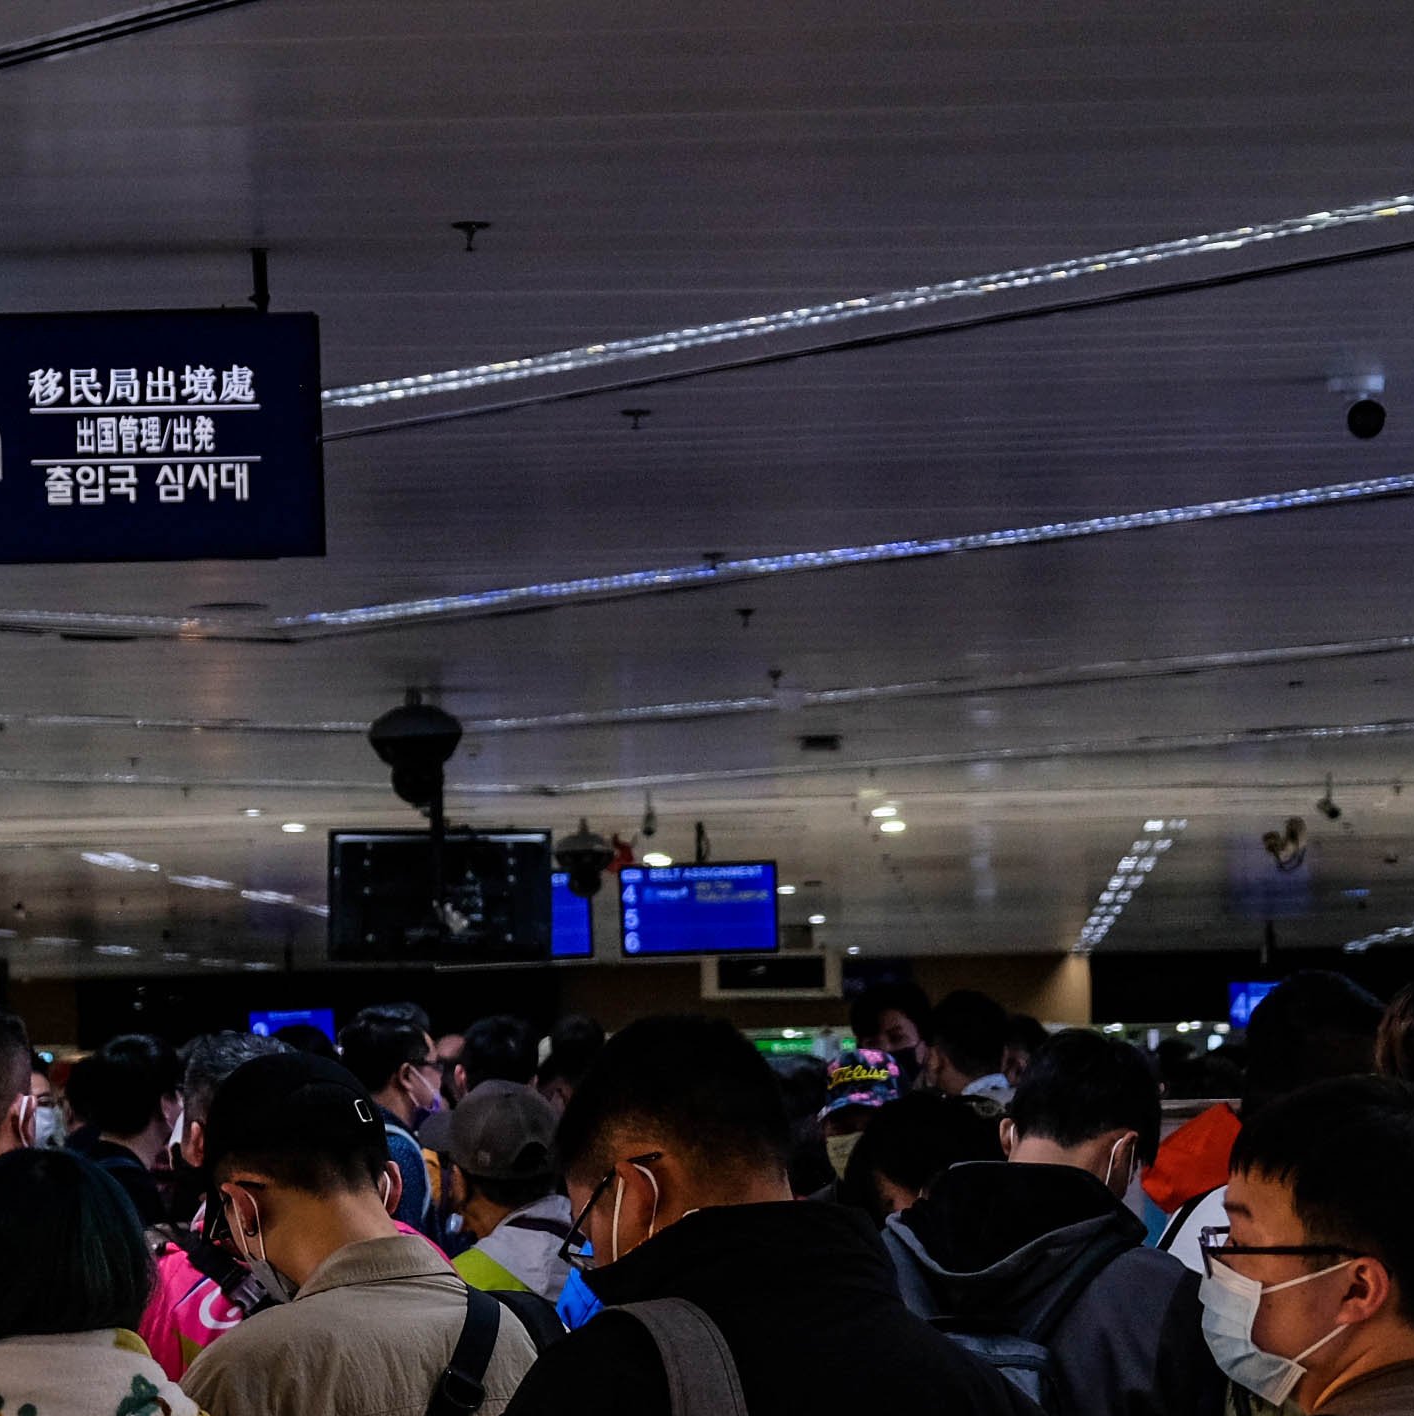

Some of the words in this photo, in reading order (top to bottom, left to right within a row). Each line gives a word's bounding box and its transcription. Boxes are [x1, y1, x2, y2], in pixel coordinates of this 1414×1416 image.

[28, 364, 256, 406] 移民局出境處
[76, 414, 216, 454] 出国管理/出発
[45, 465, 138, 506] 출입국
[155, 463, 250, 503] 심사대
